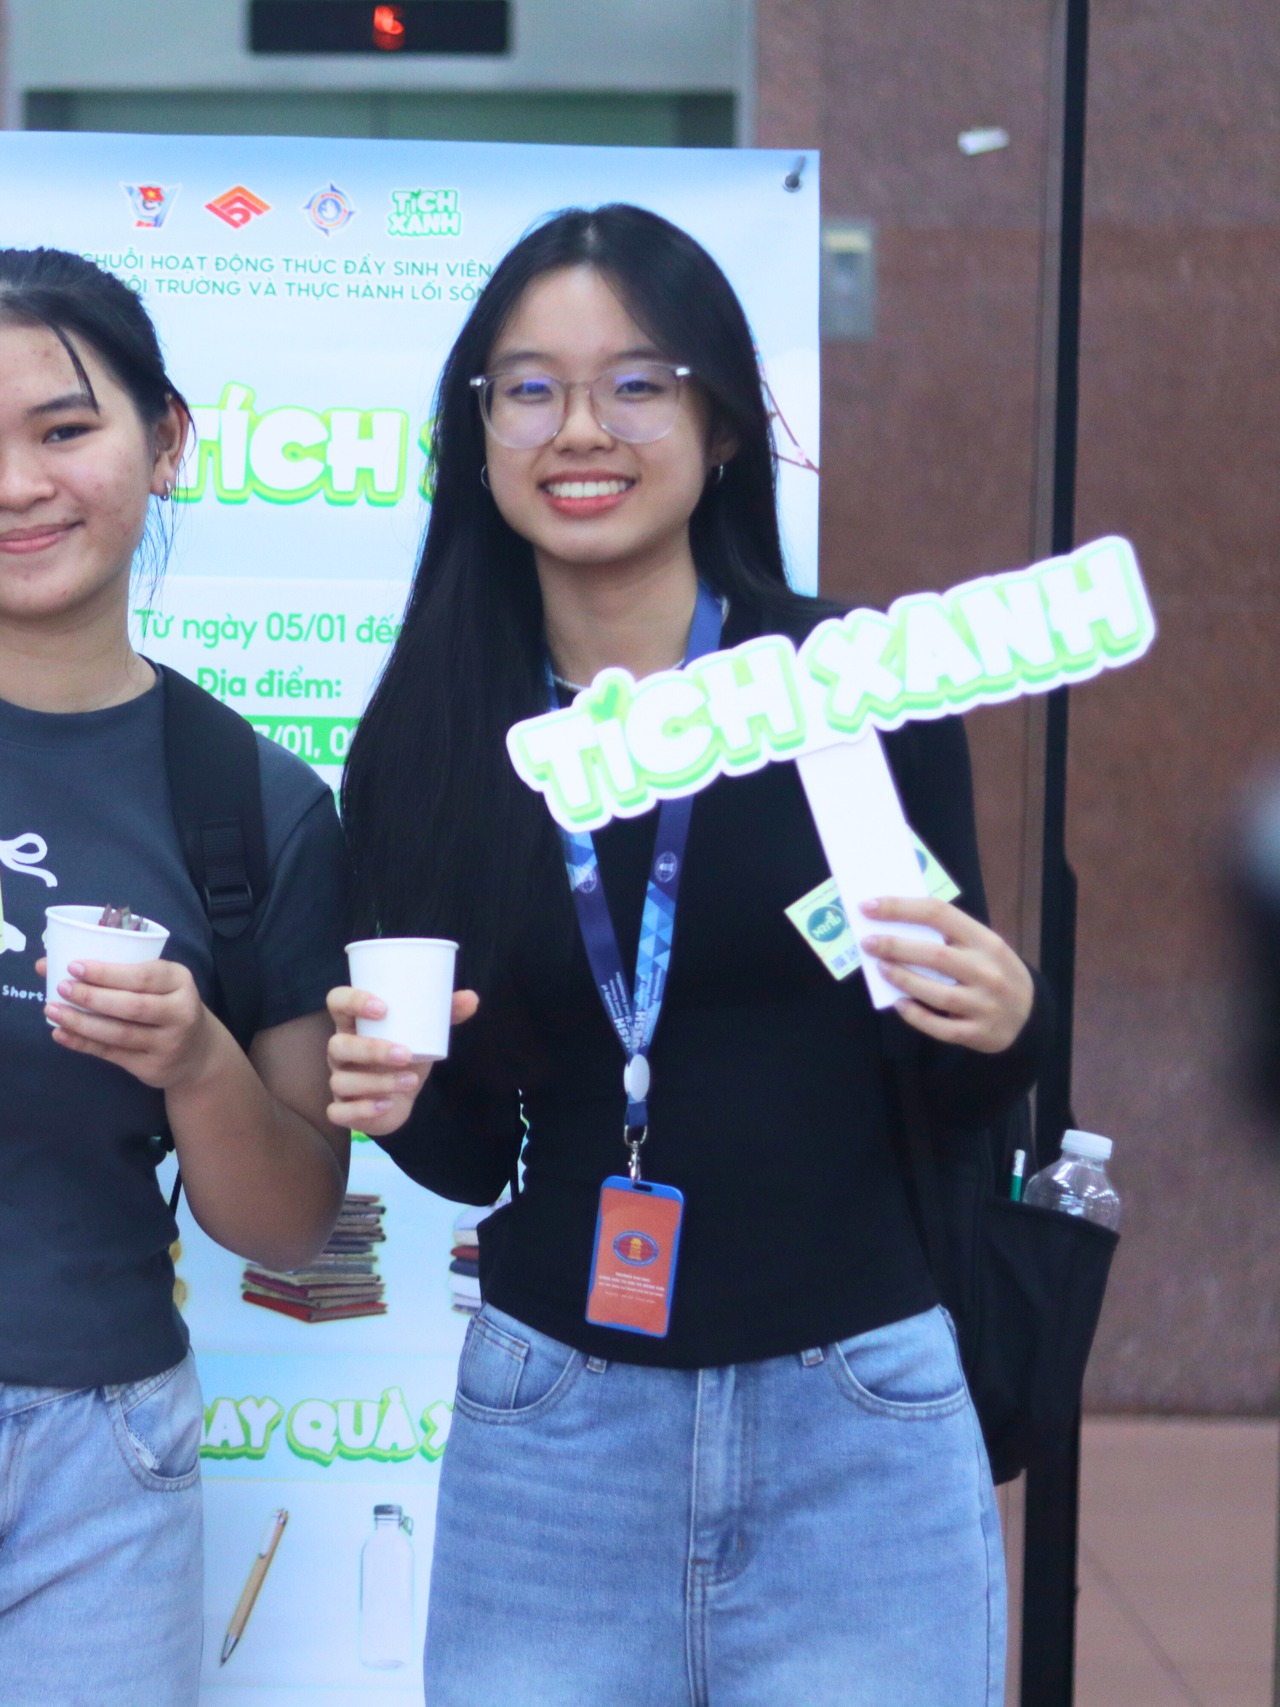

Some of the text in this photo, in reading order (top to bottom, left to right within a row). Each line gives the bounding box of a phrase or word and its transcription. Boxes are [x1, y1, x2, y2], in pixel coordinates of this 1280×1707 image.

[388, 212, 462, 236] XANH
[151, 255, 208, 274] HOẠT
[215, 252, 275, 275] ĐỘNG
[394, 260, 439, 277] SINH
[446, 258, 492, 278] VIÊN
[122, 274, 148, 293] ÔI
[155, 275, 241, 297] TRƯỜNG
[249, 277, 277, 297] VÀ
[285, 281, 341, 301] THỰC
[347, 279, 404, 299] HÀNH
[172, 381, 409, 507] TÍCH
[134, 609, 175, 639] Từ
[183, 613, 258, 650] ngày
[266, 611, 347, 643] 05/01
[807, 542, 1146, 734] XANH
[197, 665, 342, 704] Địa điểm:
[199, 1395, 285, 1460] AY
[285, 1385, 420, 1468] QUÀ
